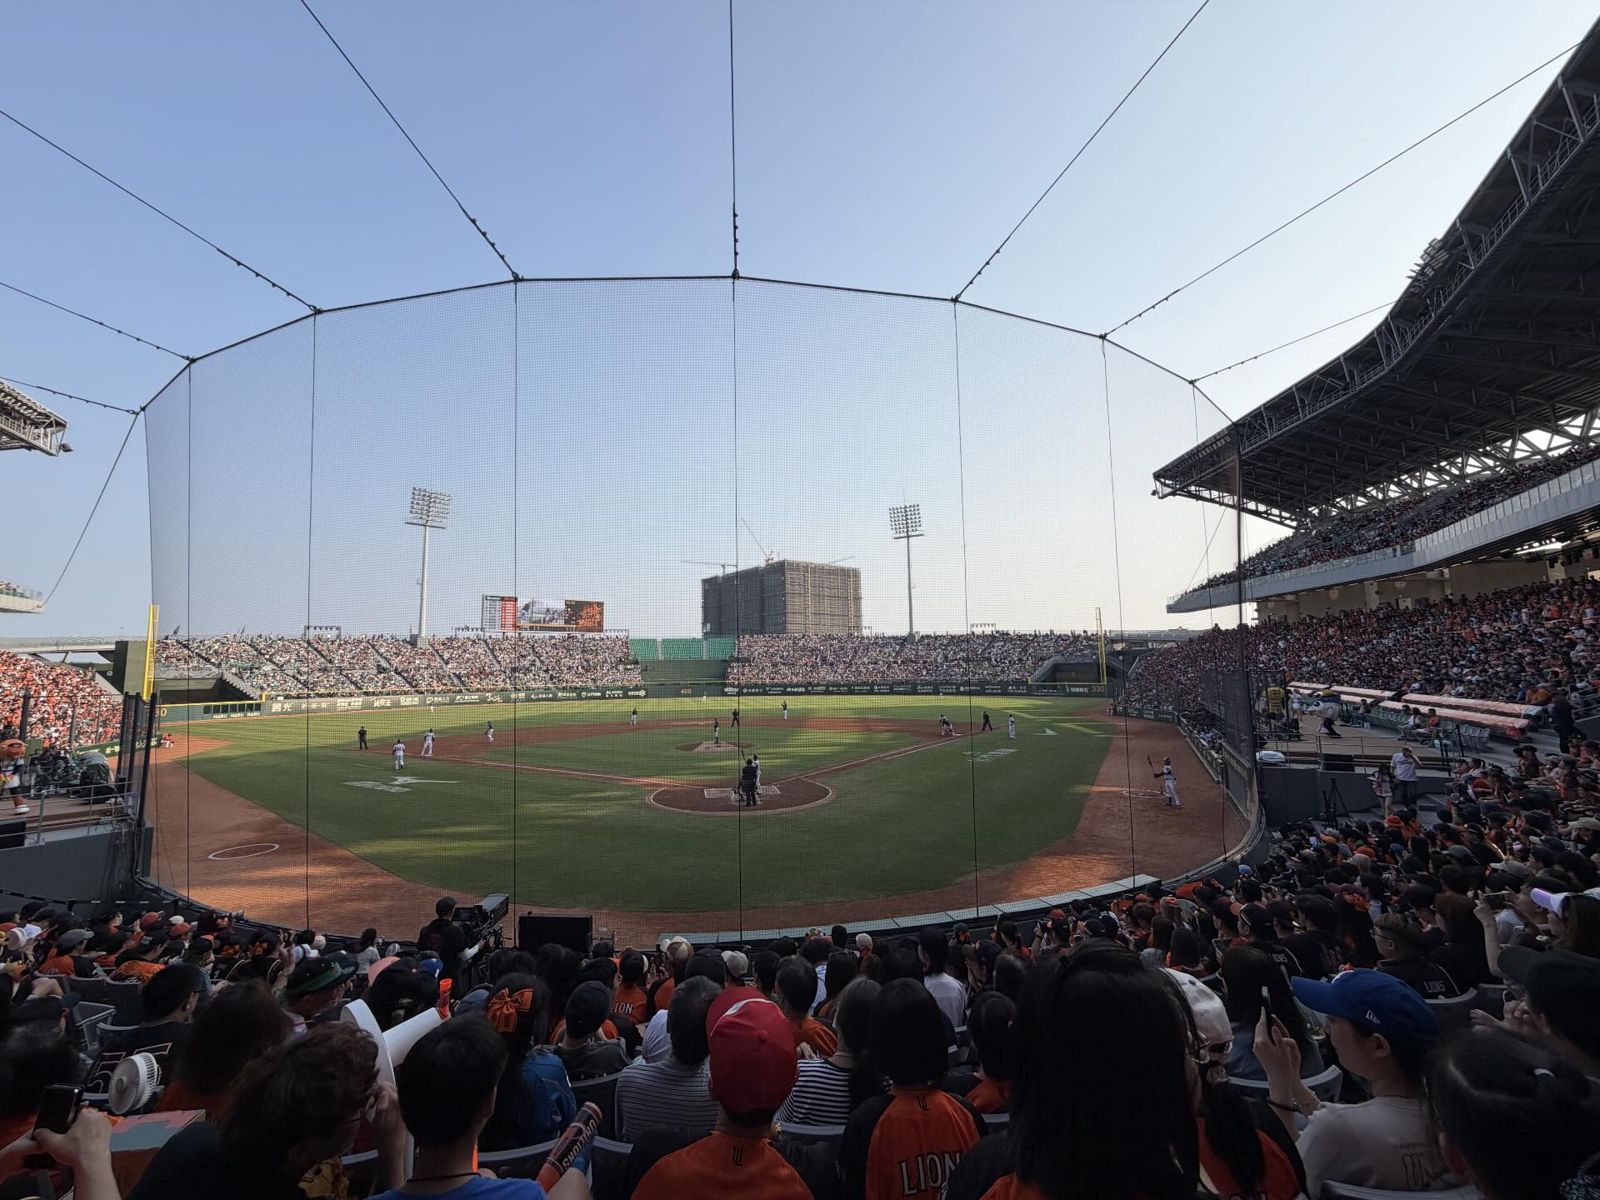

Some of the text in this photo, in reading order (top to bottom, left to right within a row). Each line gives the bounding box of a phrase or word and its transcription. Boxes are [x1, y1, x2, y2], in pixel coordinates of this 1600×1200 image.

[680, 687, 692, 695] 400
[611, 1002, 634, 1014] ION
[900, 1151, 961, 1195] LION
